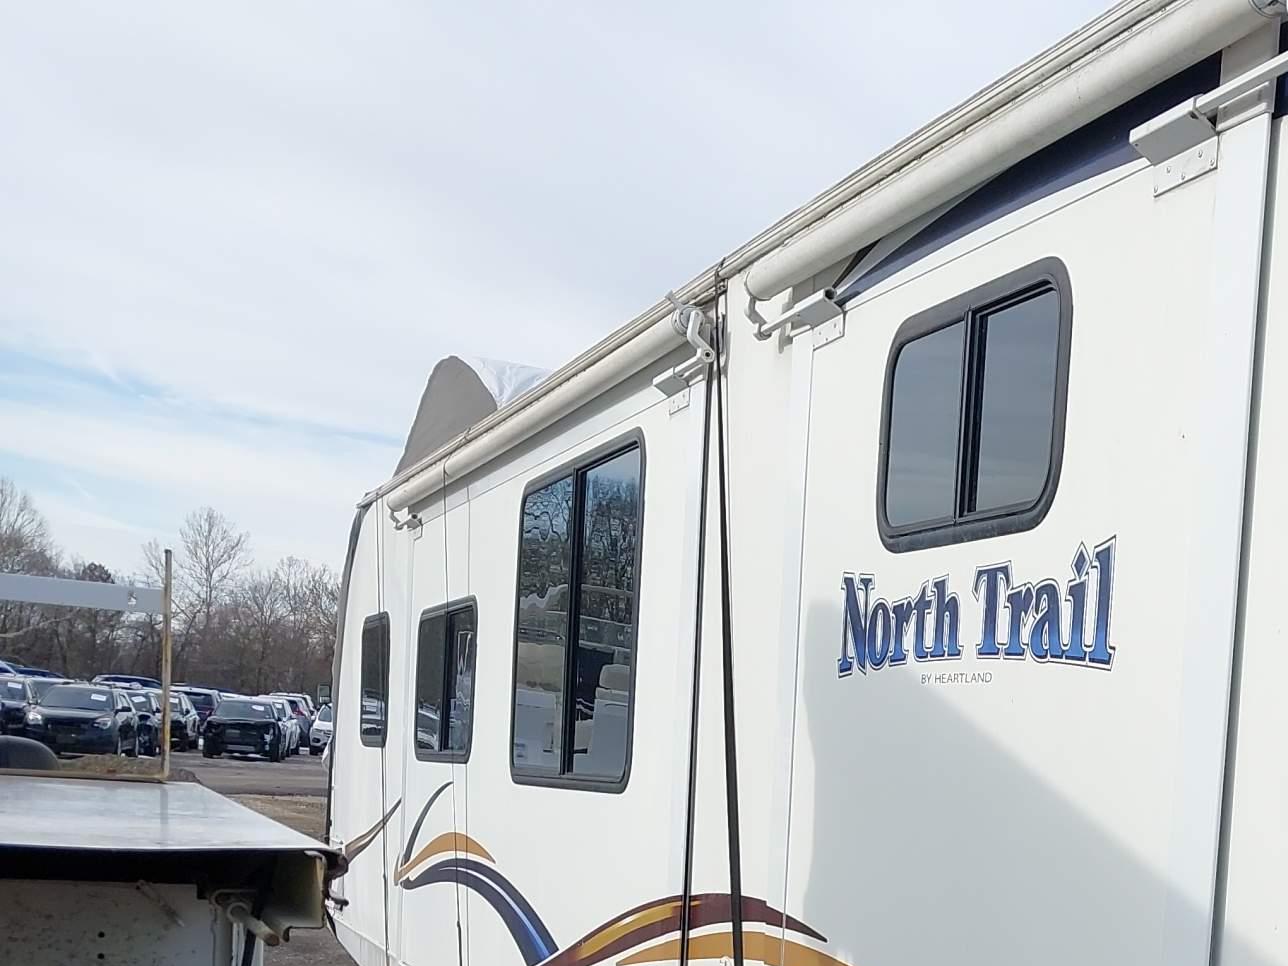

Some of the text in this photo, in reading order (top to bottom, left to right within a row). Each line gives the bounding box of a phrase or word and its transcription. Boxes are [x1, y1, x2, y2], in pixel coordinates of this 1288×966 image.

[838, 534, 1117, 678] North Trail
[921, 672, 993, 685] BY HEARTLAND
